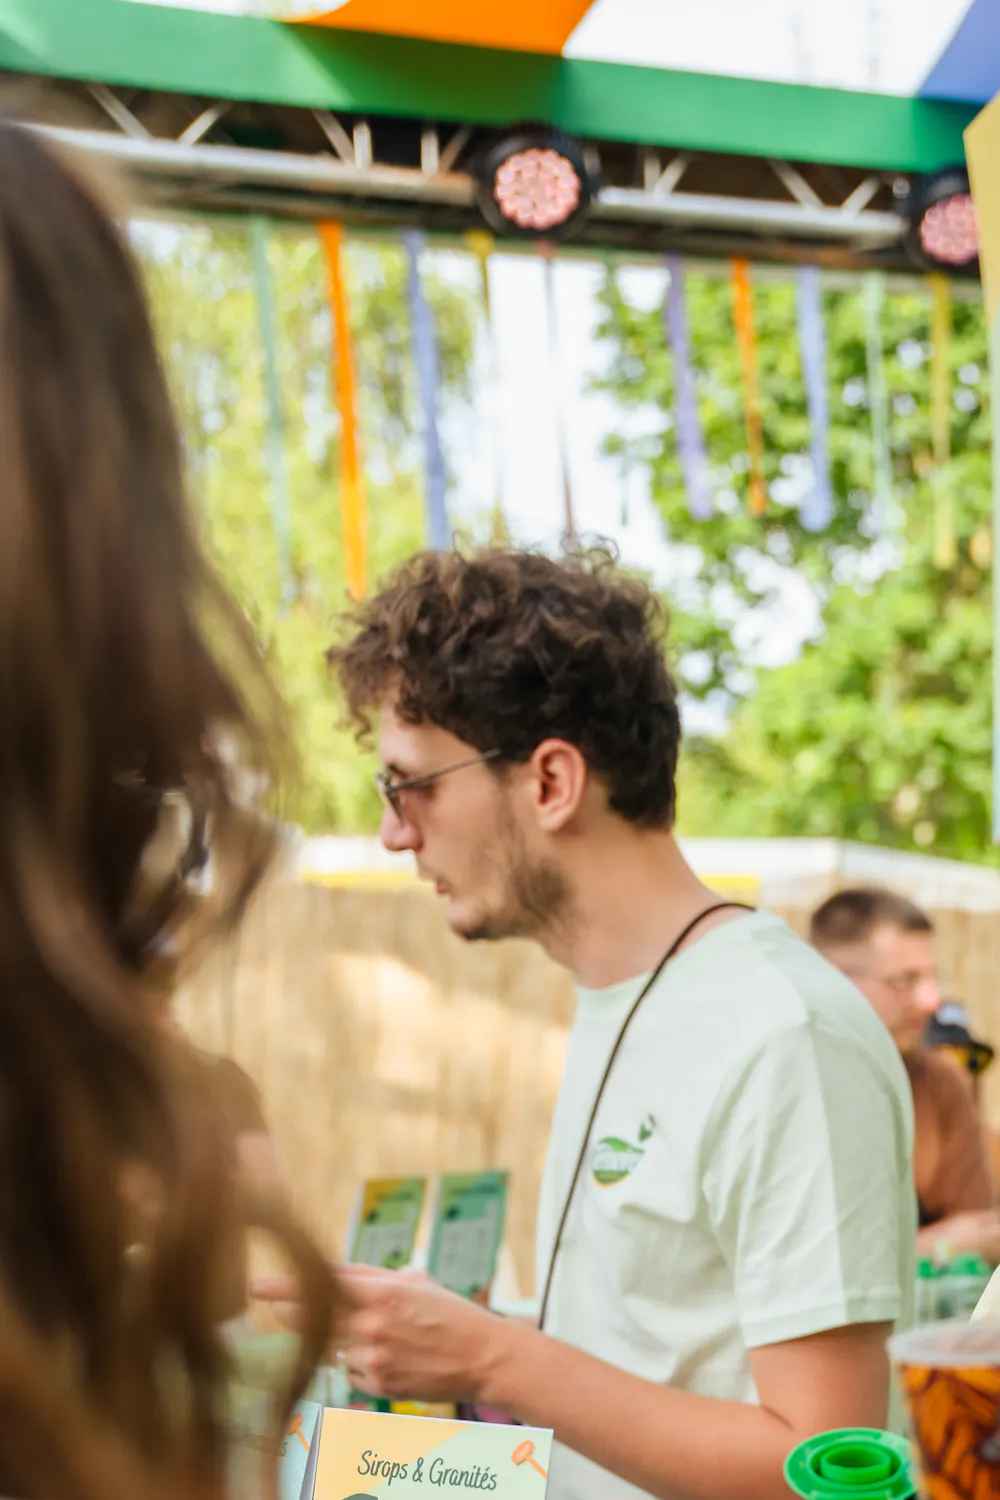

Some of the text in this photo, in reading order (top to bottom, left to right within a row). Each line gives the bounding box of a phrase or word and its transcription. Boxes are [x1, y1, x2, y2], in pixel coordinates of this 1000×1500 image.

[357, 1450, 498, 1491] Sirops & Granités
